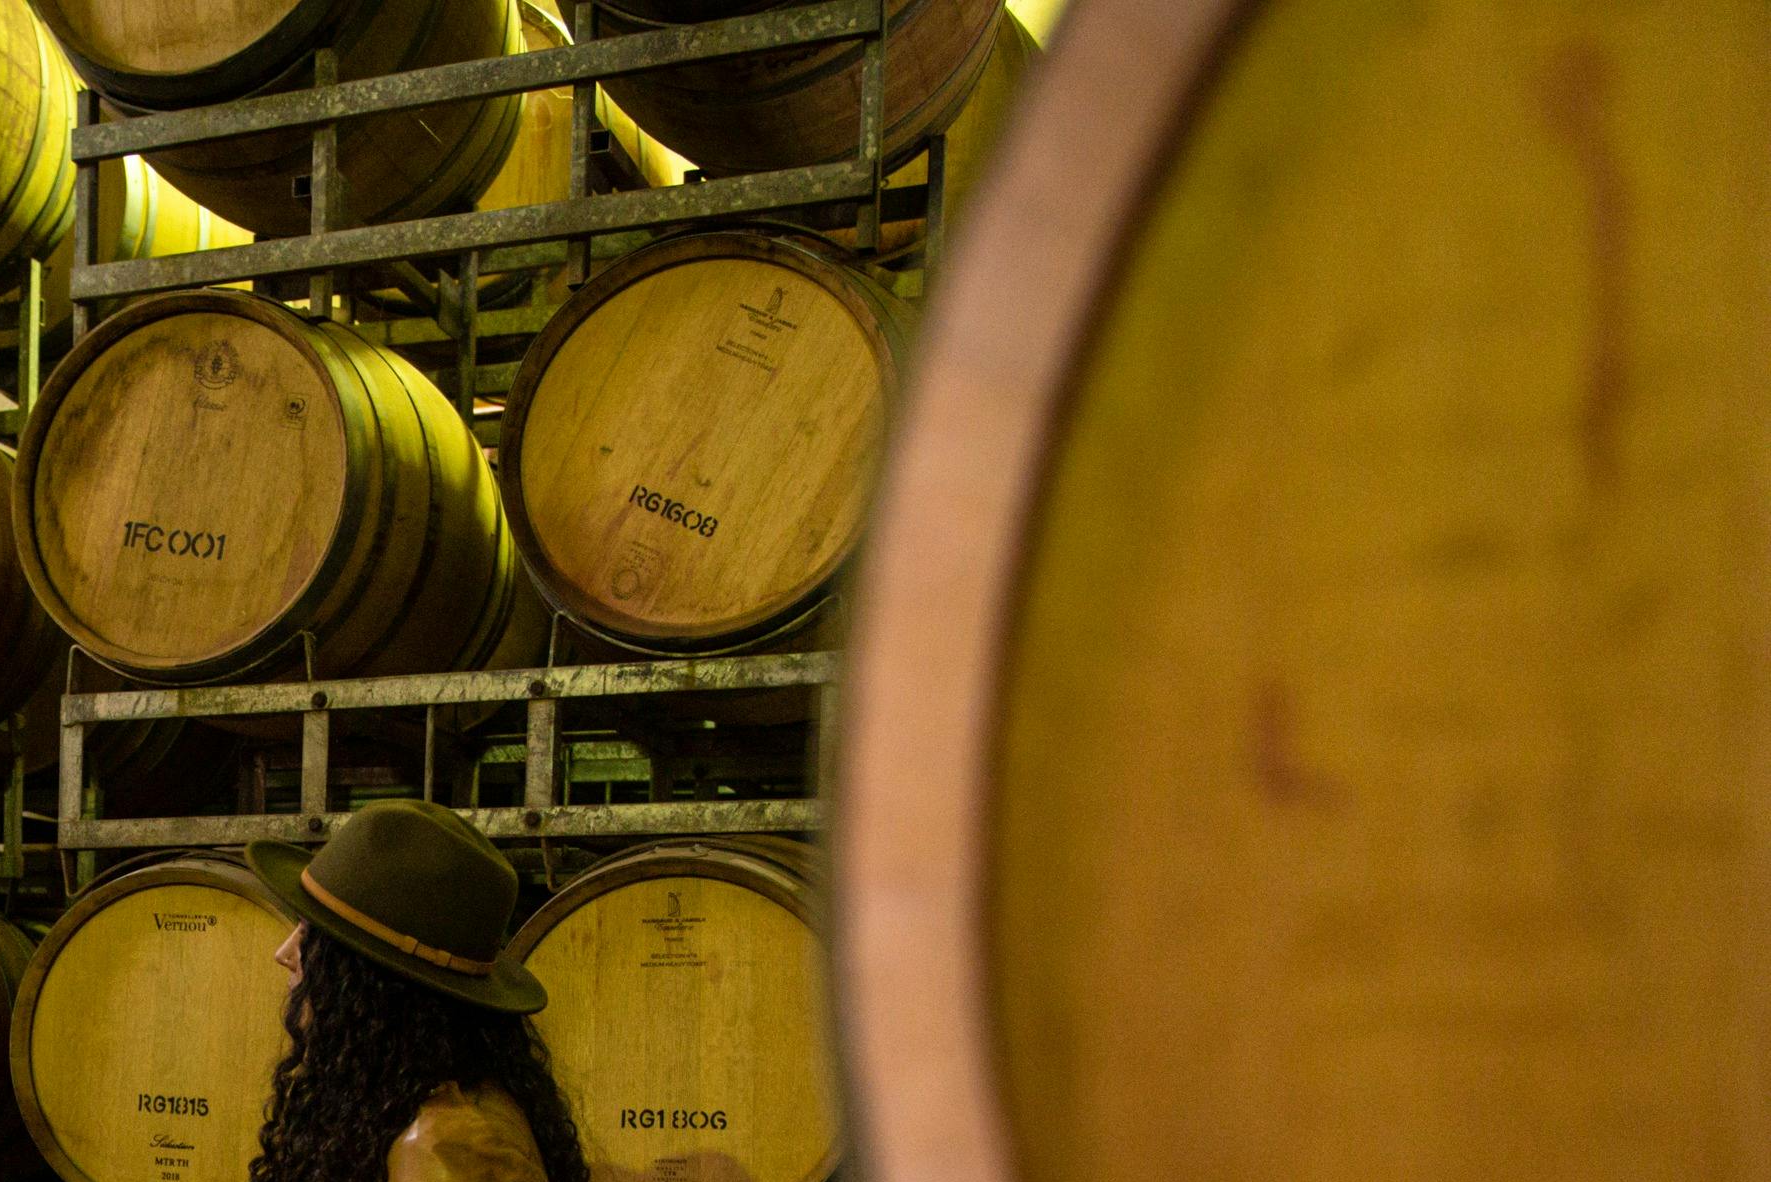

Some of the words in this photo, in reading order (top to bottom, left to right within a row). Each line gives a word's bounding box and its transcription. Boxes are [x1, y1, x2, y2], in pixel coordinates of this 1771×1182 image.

[628, 484, 719, 538] RG1608
[138, 1093, 209, 1117] RG1815
[161, 1172, 180, 1181] 2018
